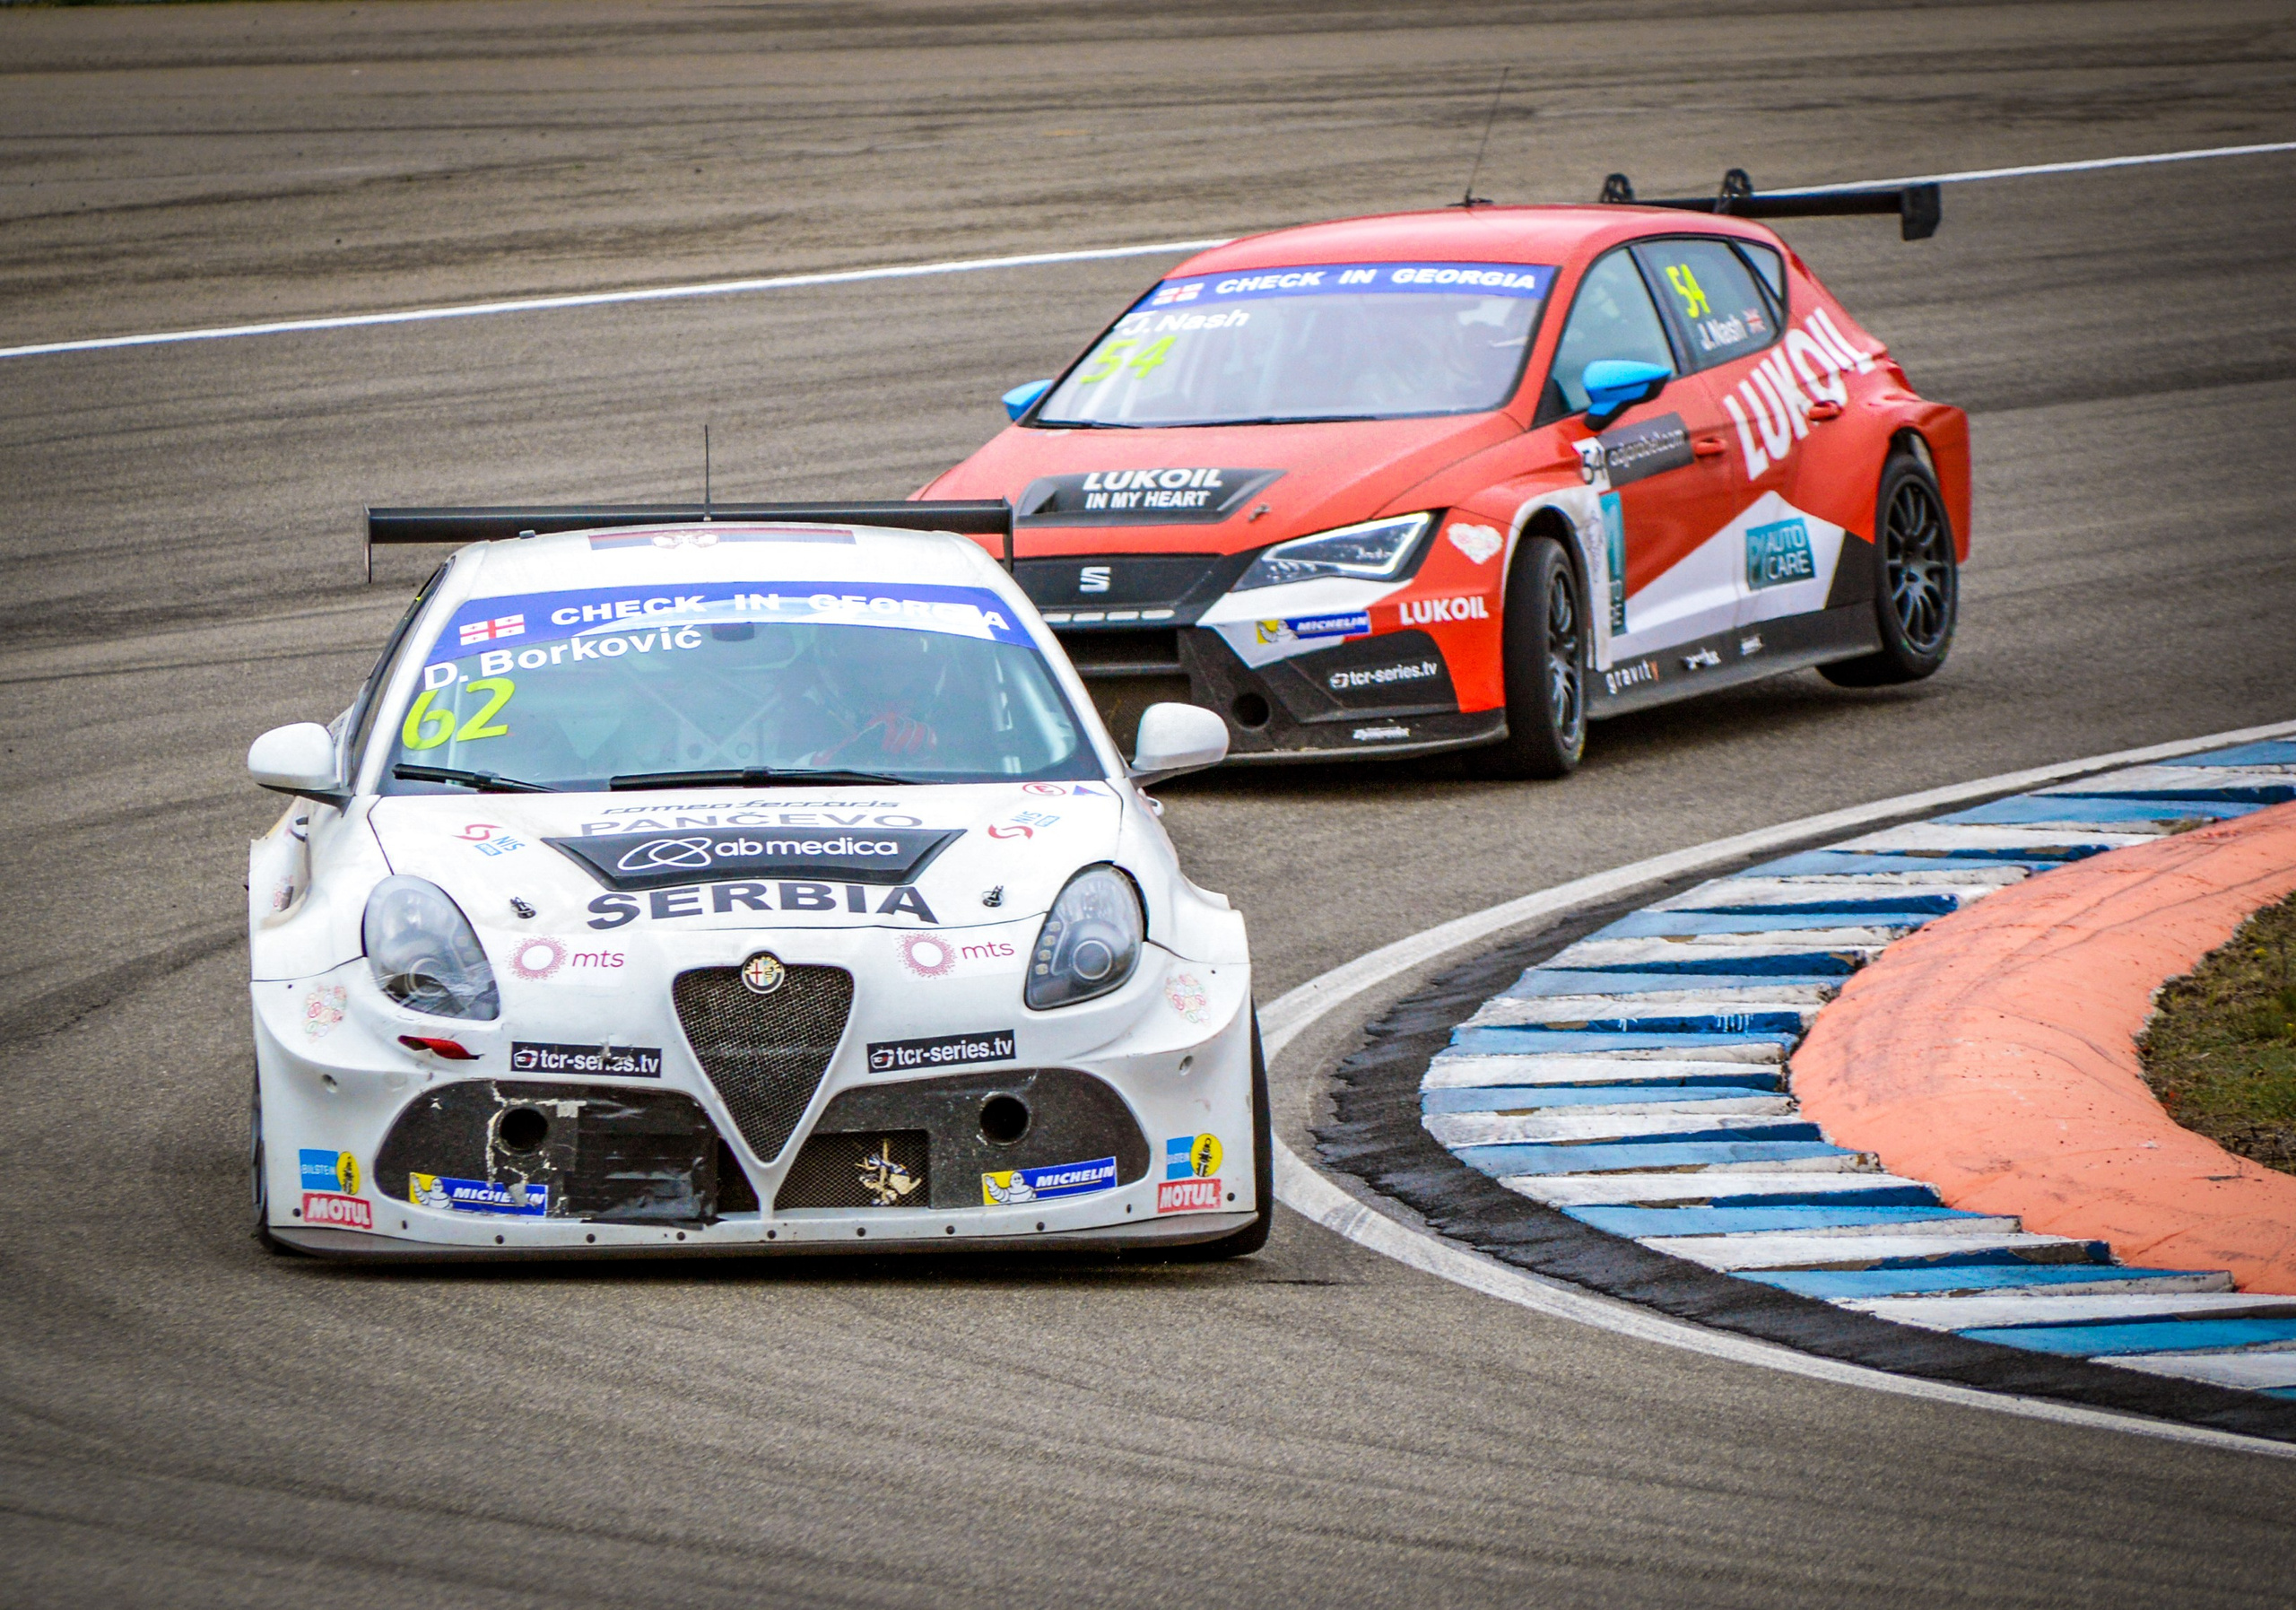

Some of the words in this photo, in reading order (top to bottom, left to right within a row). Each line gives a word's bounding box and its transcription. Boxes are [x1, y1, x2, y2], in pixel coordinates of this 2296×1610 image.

[1215, 271, 1326, 294] CHECK
[1338, 269, 1378, 284] IN
[1392, 268, 1536, 290] GEORGIA
[1665, 263, 1710, 318] 54
[1122, 318, 1152, 335] J.
[1154, 309, 1250, 333] Nash
[1080, 335, 1177, 384] 54
[1723, 307, 1876, 482] LUKOIL
[1082, 467, 1223, 492] LUKOIL
[1084, 492, 1109, 509] IN
[1110, 491, 1143, 509] MY
[1144, 490, 1211, 508] HEART
[1766, 525, 1805, 553] AUTO
[1768, 549, 1812, 579] CARE
[550, 595, 708, 625] CHECK
[734, 593, 780, 611] IN
[807, 593, 1010, 630] GEORGA
[1295, 615, 1369, 632] MICHELIN
[1399, 596, 1490, 626] LUKOIL
[423, 662, 469, 691] D.
[480, 624, 703, 677] Borković
[1349, 661, 1438, 686] tcr-series.tv
[401, 677, 516, 751] 62
[581, 811, 924, 835] PANČEVO
[586, 883, 940, 930] SERBIA
[571, 950, 624, 968] mts
[961, 941, 1015, 960] mts
[897, 1038, 1013, 1066] tcr-series.tv
[1035, 1165, 1116, 1188] MICHELIN
[1159, 1183, 1218, 1209] MOTUL
[307, 1197, 370, 1225] MOTUL
